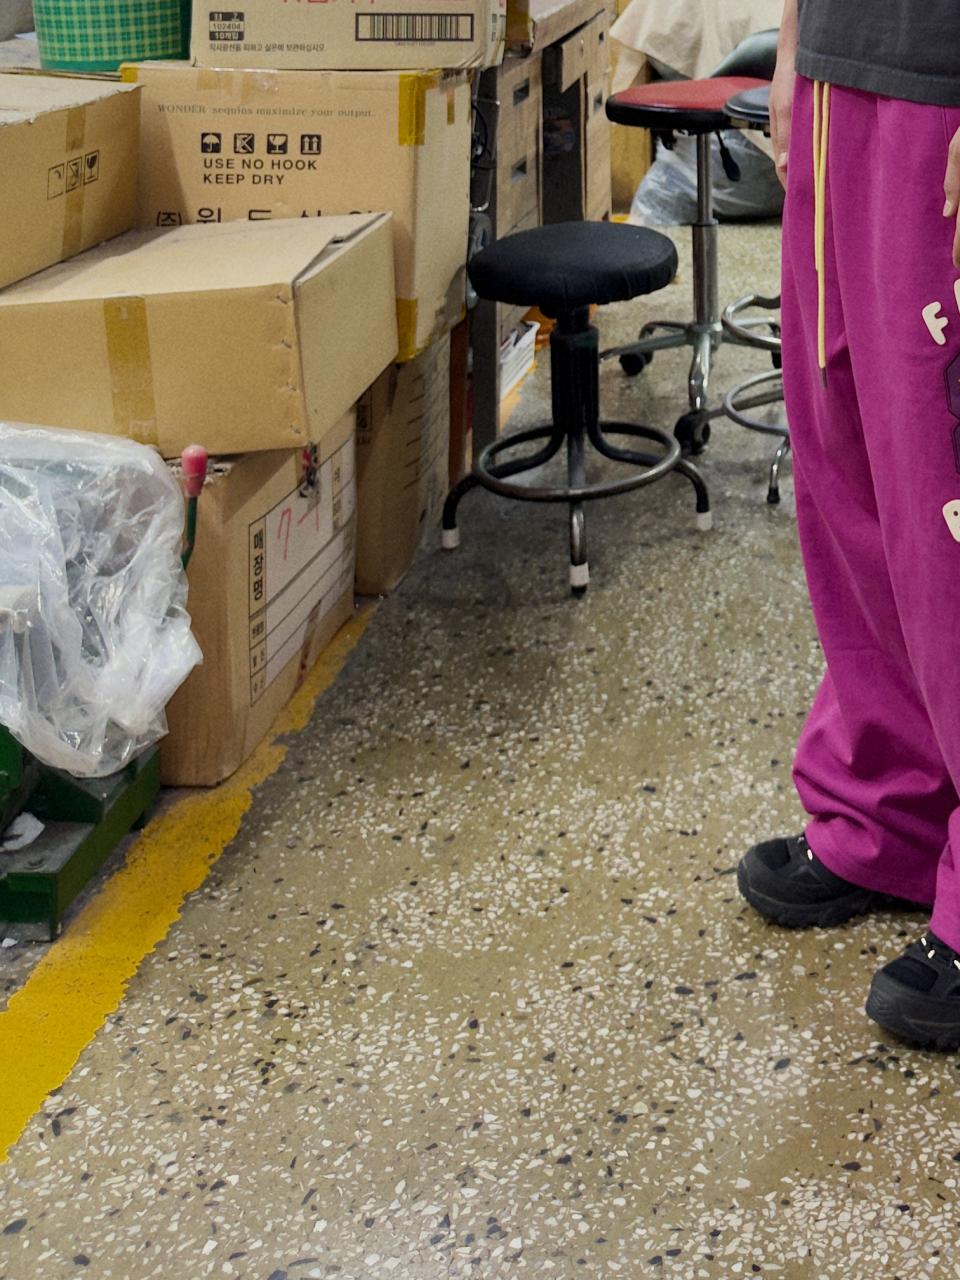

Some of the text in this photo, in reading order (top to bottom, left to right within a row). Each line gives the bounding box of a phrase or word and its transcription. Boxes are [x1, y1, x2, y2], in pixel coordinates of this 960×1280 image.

[203, 158, 318, 170] USE NO HOOK
[203, 173, 286, 185] KEEP DRY
